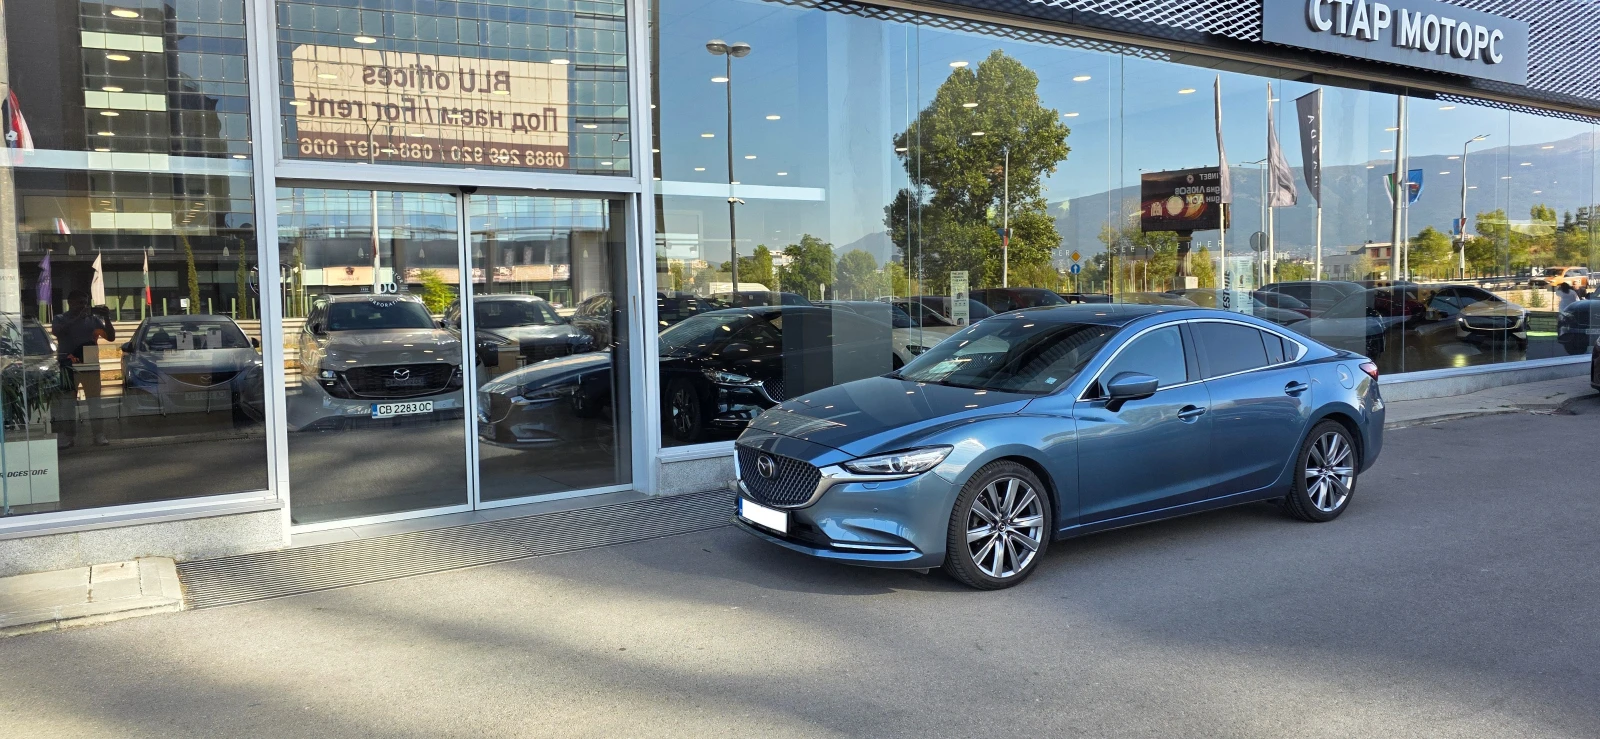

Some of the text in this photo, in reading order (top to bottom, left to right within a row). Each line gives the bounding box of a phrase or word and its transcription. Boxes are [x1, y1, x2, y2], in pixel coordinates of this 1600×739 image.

[1311, 0, 1504, 64] СТАР МОТОРС
[379, 404, 392, 415] CB
[394, 403, 416, 414] 2283
